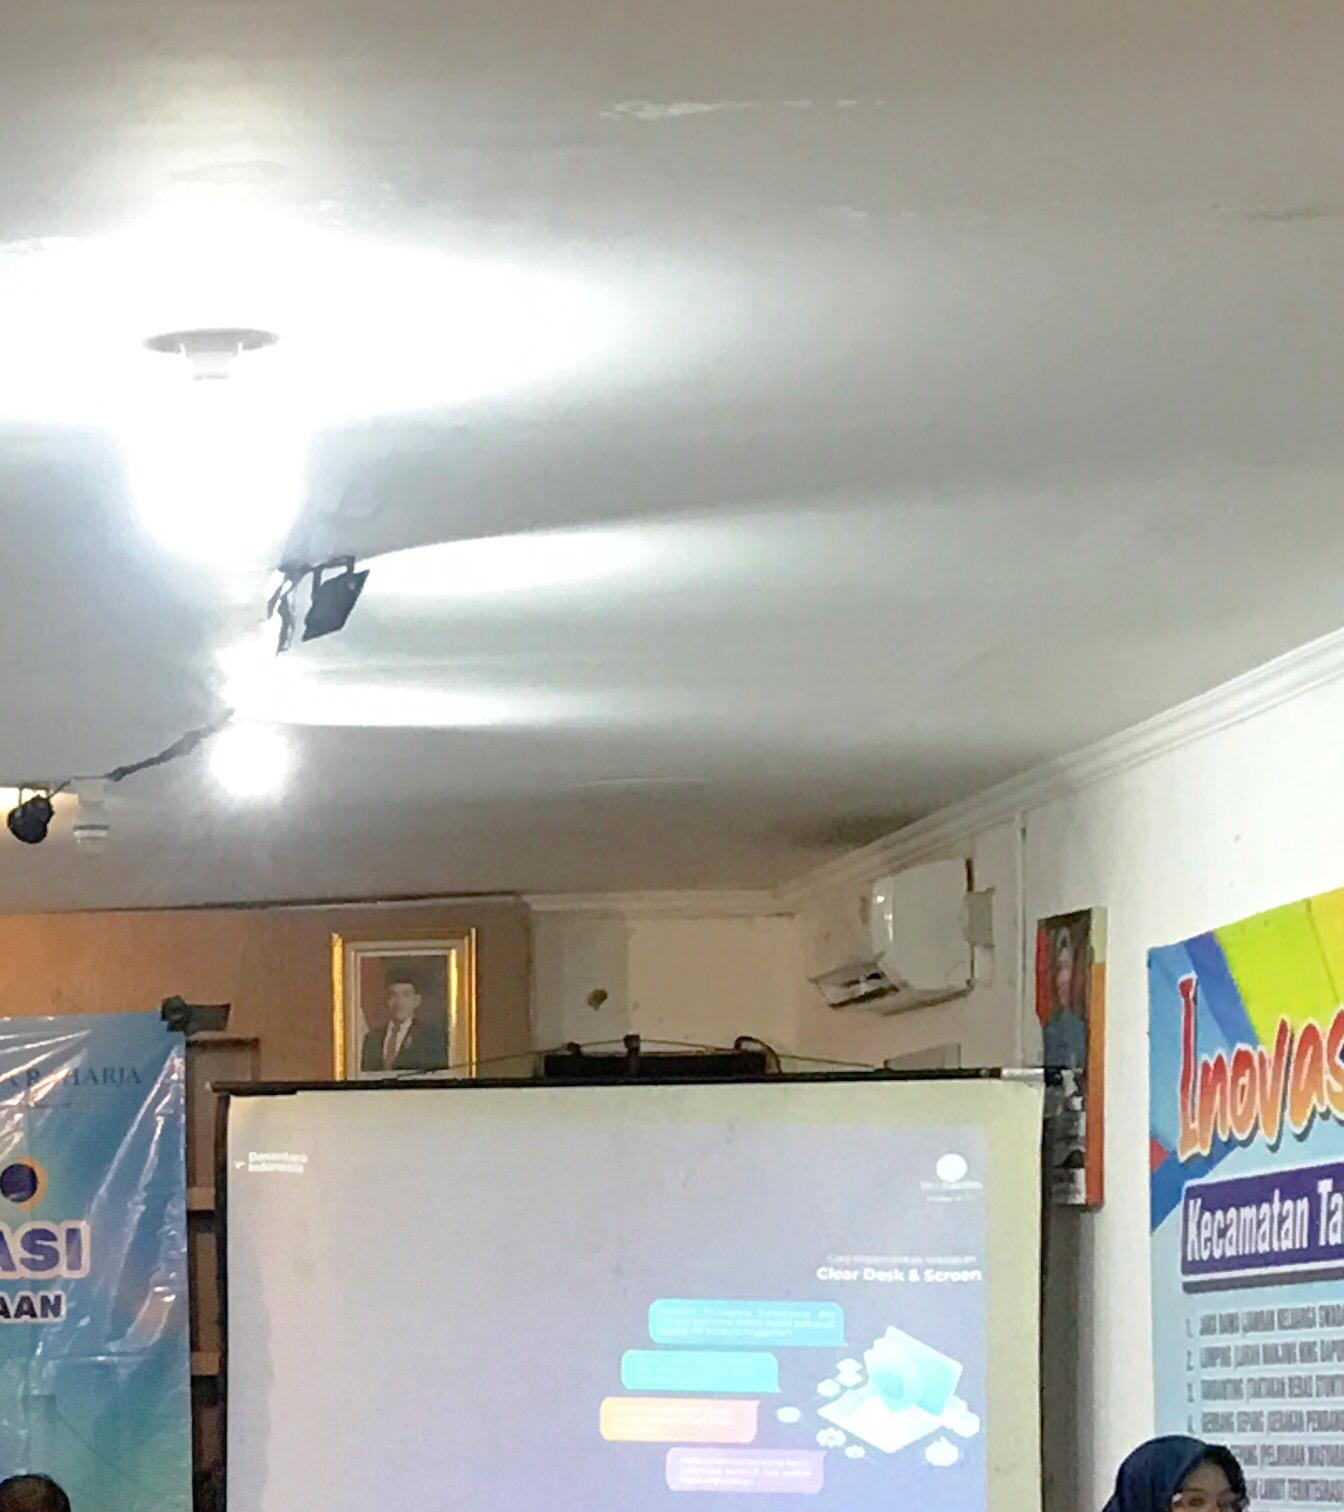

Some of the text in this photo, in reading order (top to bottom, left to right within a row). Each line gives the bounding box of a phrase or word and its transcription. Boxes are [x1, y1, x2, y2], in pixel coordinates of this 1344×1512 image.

[1187, 1188, 1309, 1262] Kecamatan
[815, 1266, 860, 1281] Clear
[863, 1267, 905, 1282] Desk
[923, 1268, 983, 1283] Screen
